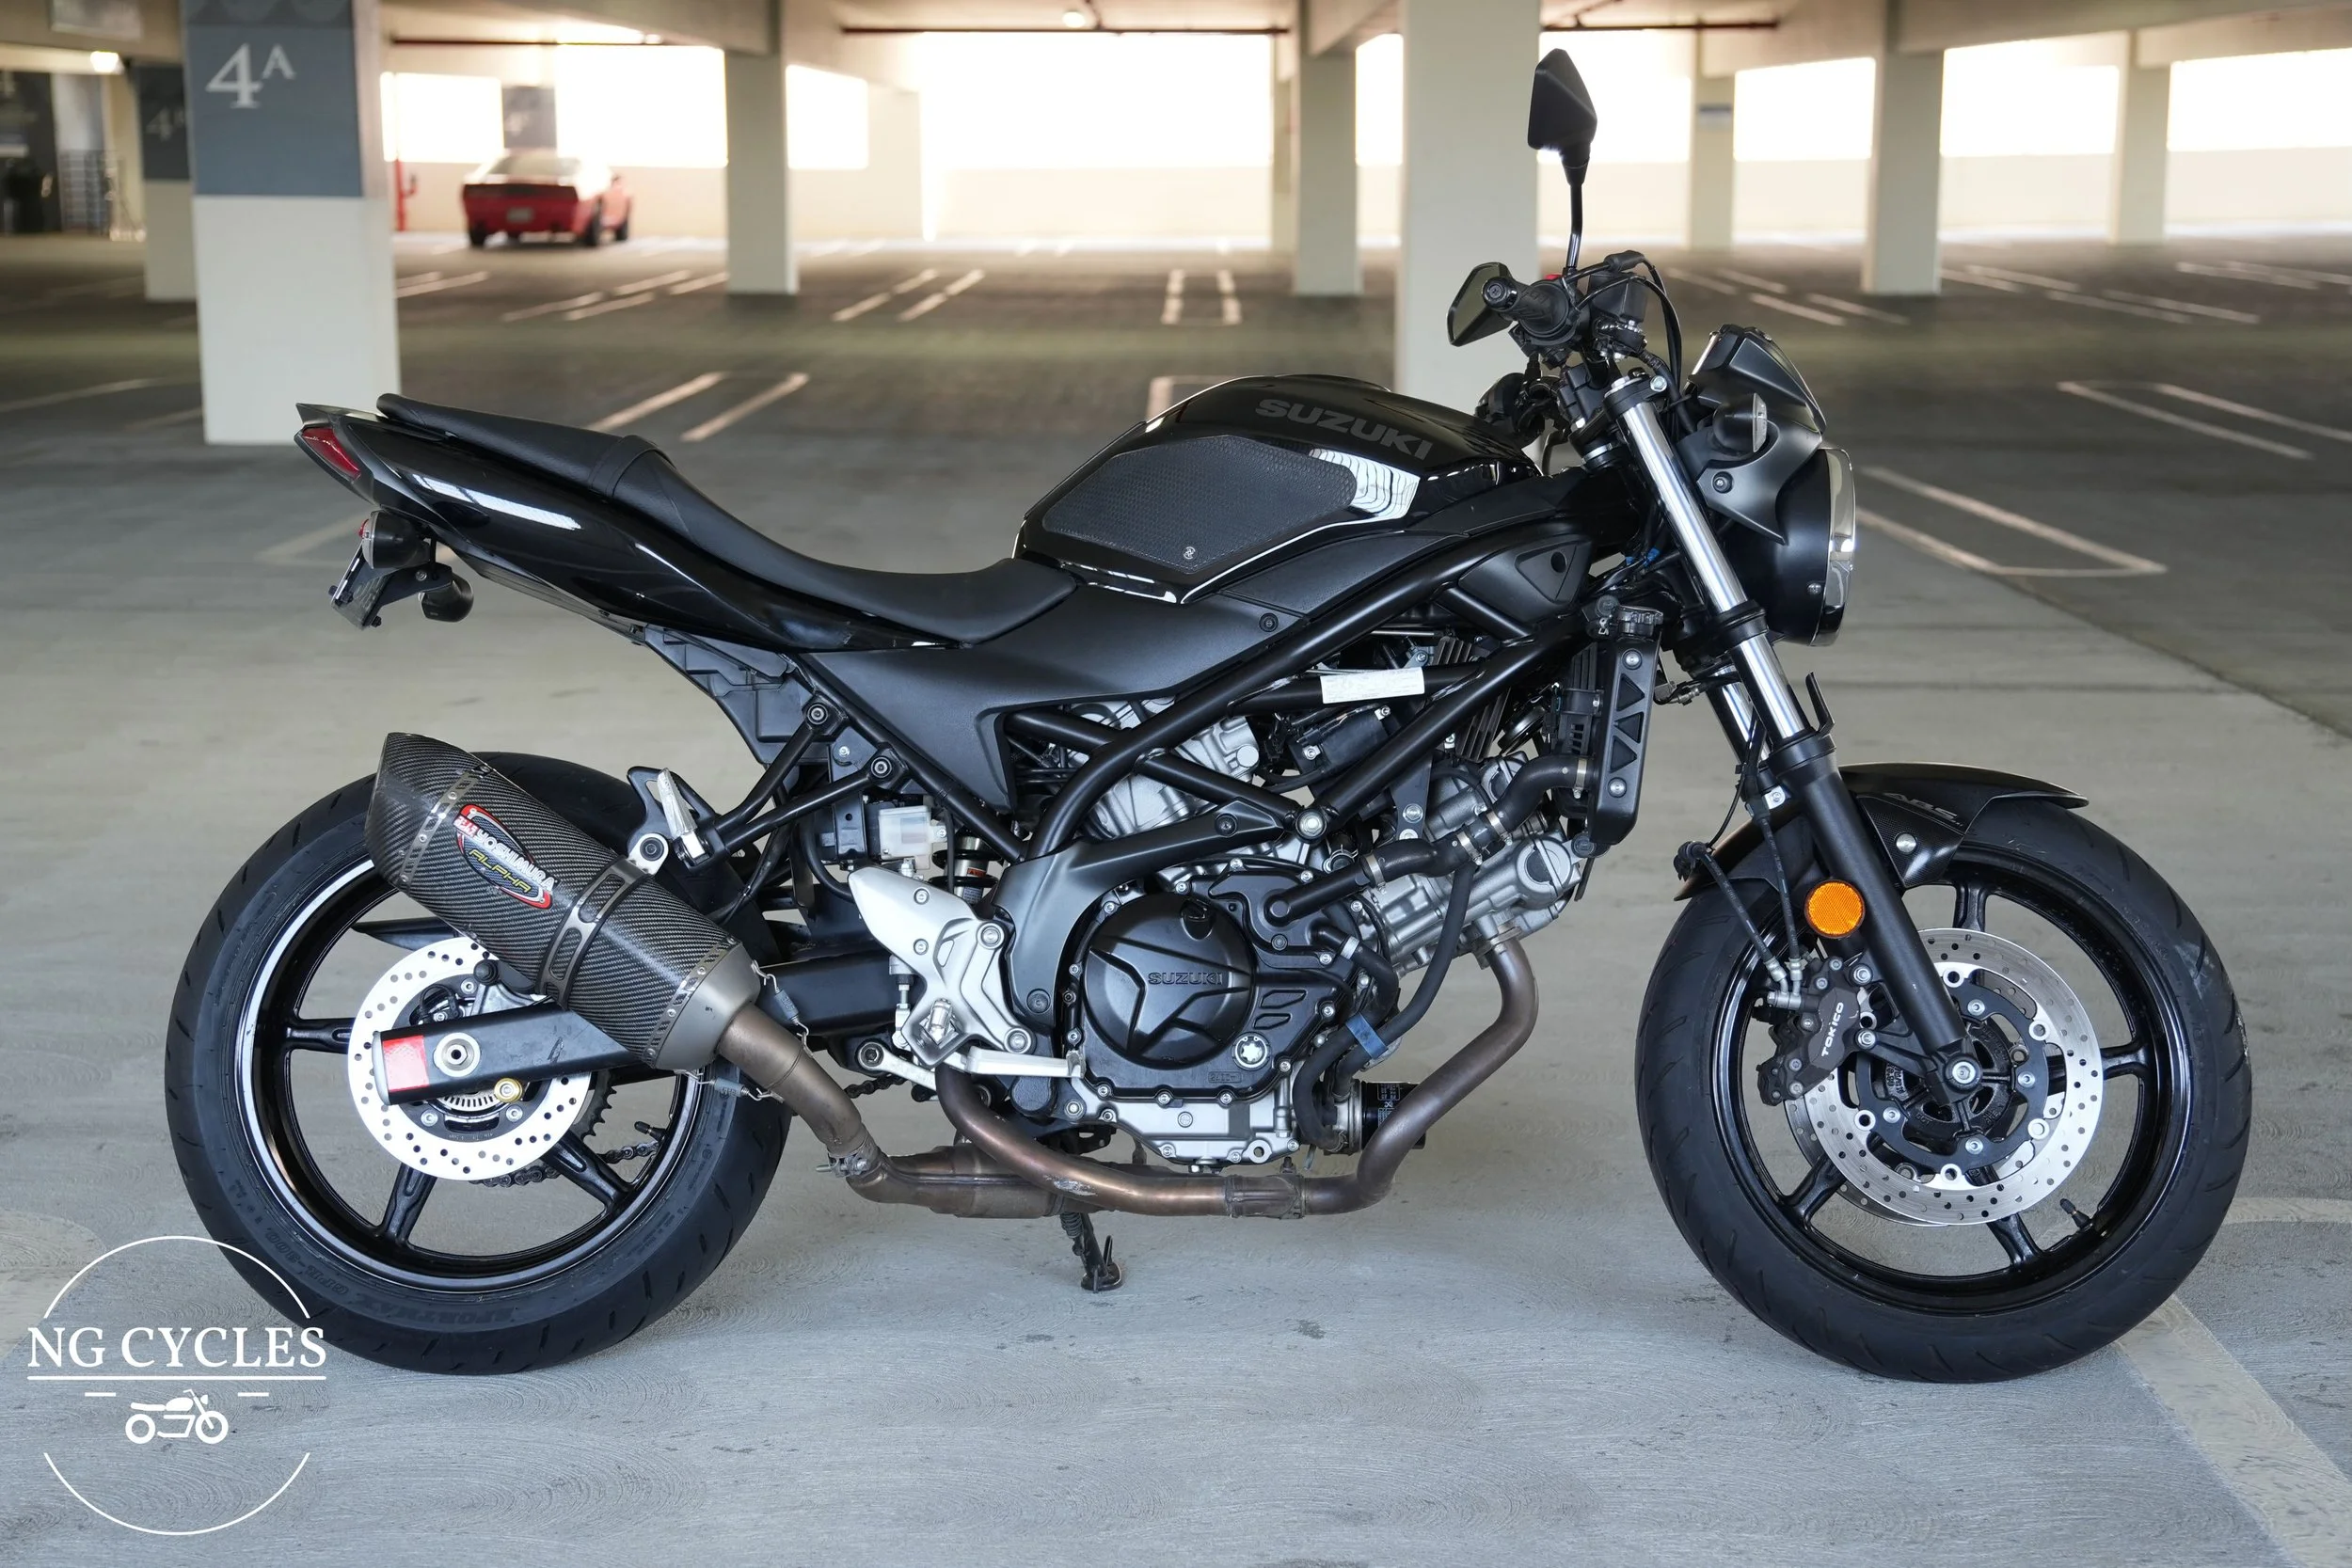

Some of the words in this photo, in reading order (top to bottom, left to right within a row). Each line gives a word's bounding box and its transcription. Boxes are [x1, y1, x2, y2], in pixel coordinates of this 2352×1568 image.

[205, 42, 296, 109] 4A
[1255, 399, 1432, 460] SUZUKI
[469, 848, 532, 894] ALPHA
[472, 828, 555, 895] YOSHIMURA
[1148, 972, 1223, 985] SUZUKI
